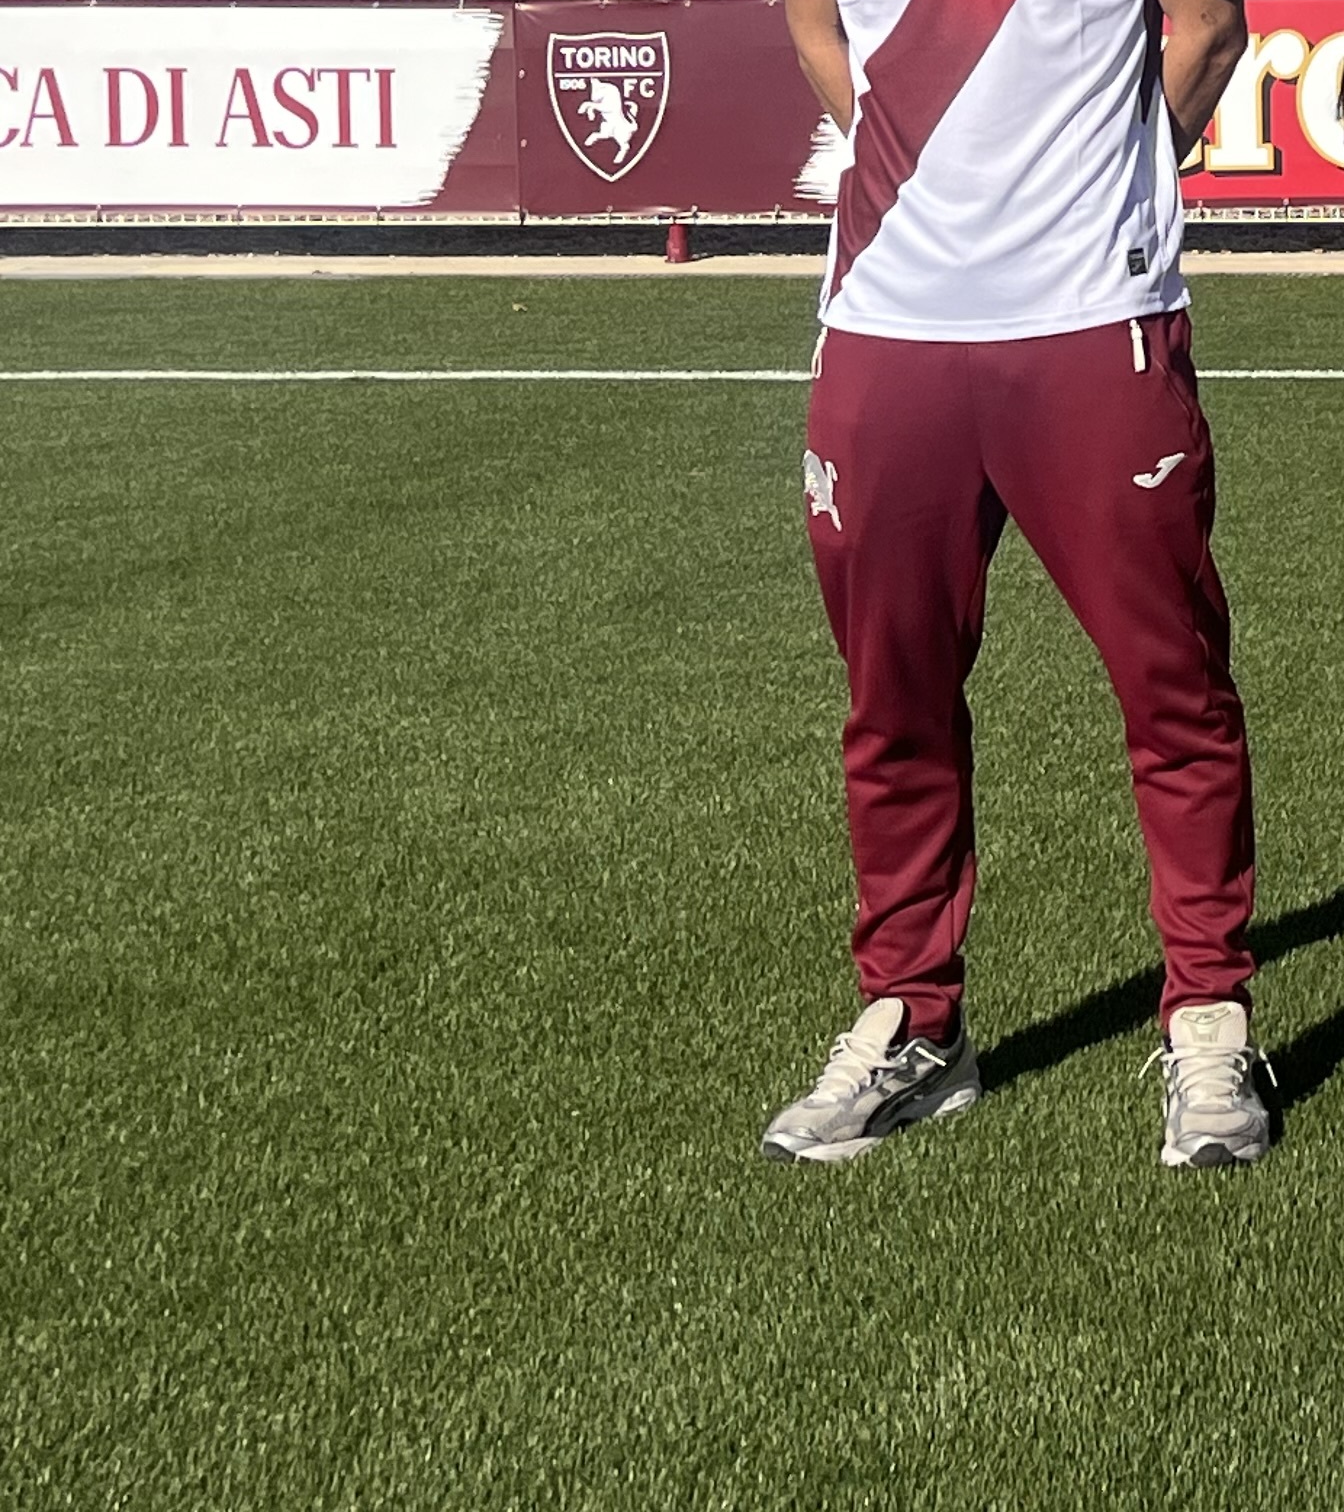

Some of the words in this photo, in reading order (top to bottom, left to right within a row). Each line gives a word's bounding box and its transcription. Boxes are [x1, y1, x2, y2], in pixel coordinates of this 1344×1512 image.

[560, 46, 656, 68] TORINO
[623, 78, 655, 98] FC
[103, 67, 189, 148] DI
[215, 67, 397, 149] ASTI
